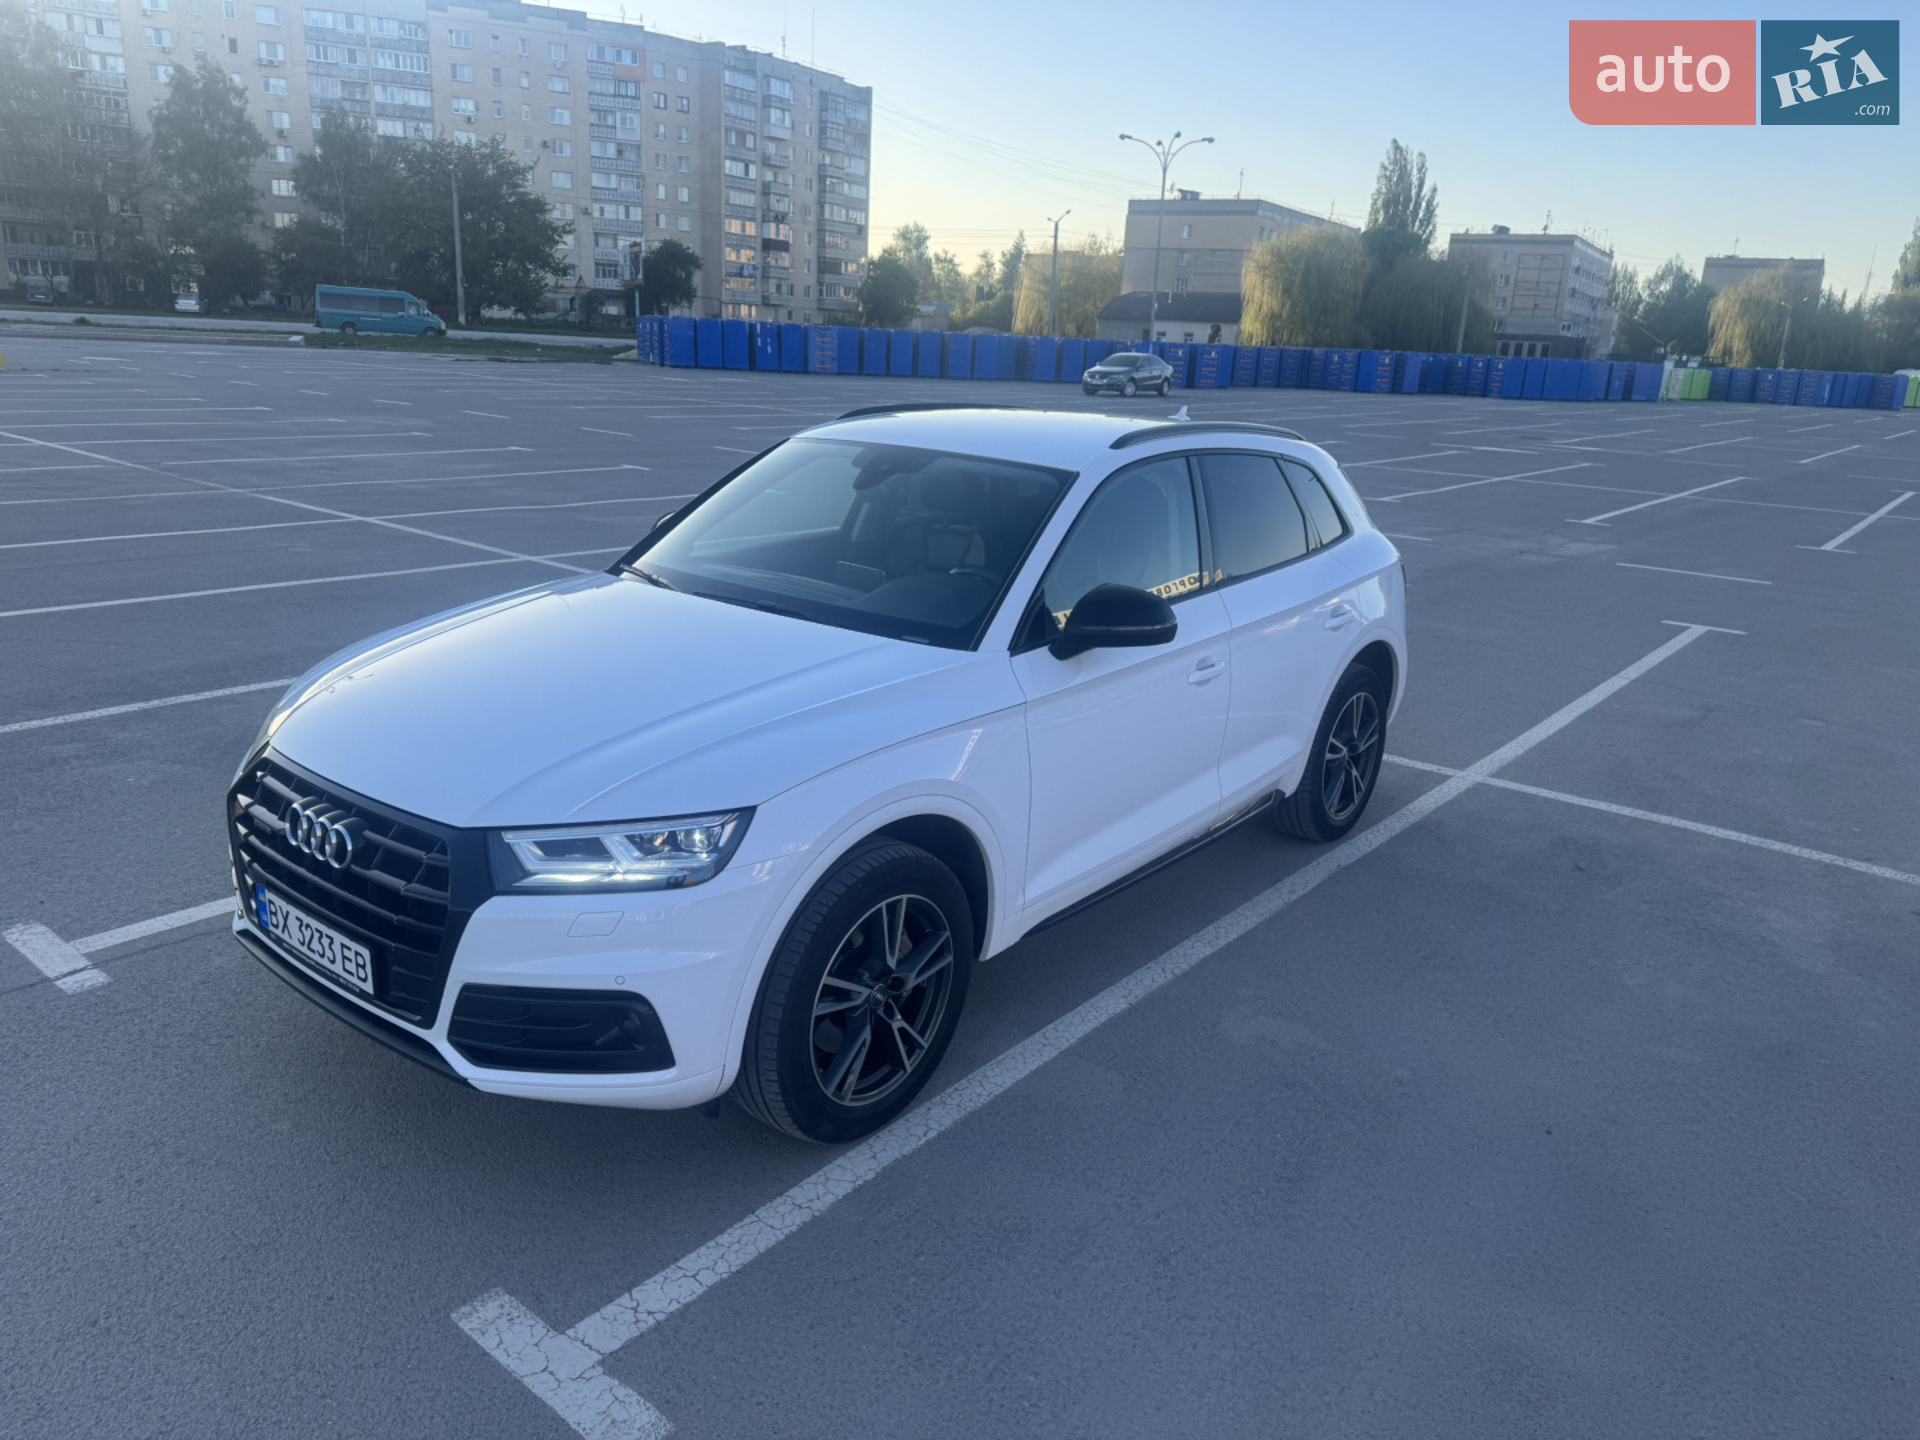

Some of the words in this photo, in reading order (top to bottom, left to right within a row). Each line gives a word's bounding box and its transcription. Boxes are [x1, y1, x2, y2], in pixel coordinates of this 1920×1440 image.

[267, 898, 293, 941] BX
[295, 915, 337, 966] 3233
[340, 941, 369, 984] EB
